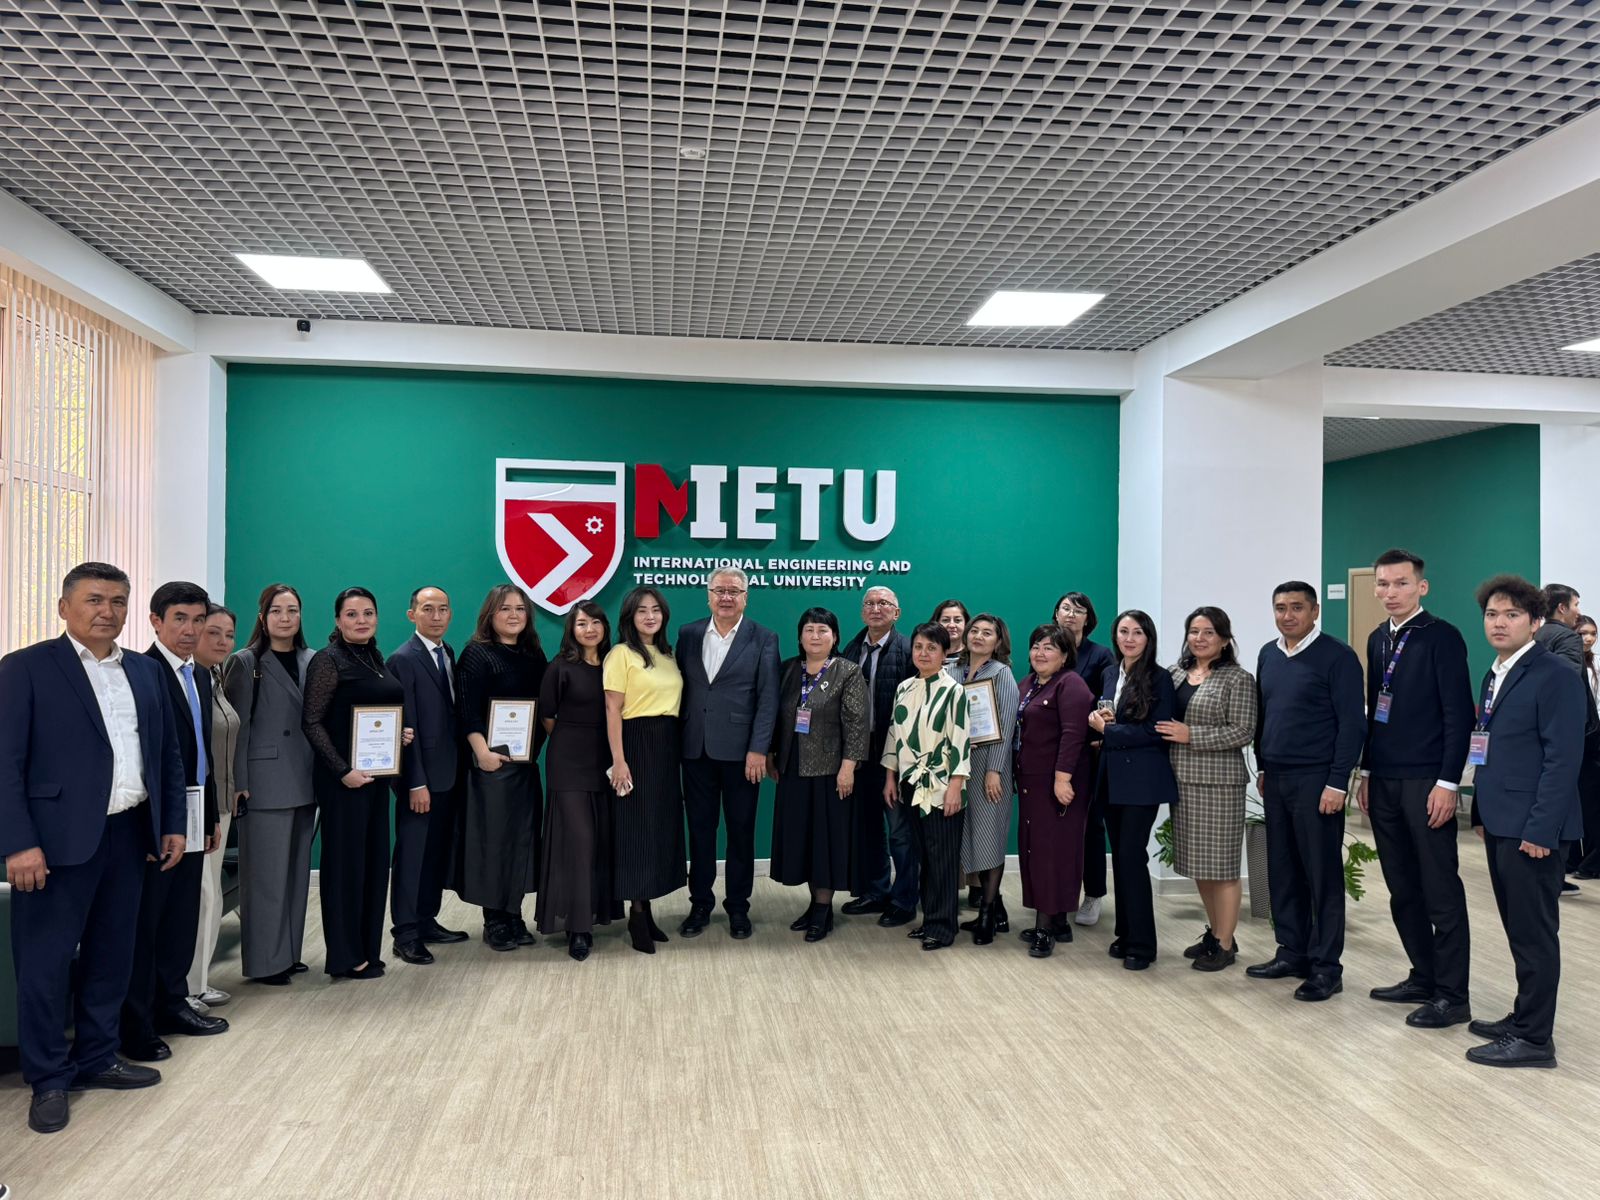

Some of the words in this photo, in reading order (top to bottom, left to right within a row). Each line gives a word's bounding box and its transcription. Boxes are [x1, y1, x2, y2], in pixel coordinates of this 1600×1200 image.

[634, 463, 897, 542] MIETU
[633, 556, 763, 570] INTERNATIONAL
[768, 558, 874, 571] ENGINEERING
[878, 560, 911, 572] AND
[633, 573, 769, 586] TECHNOLAL
[773, 575, 867, 588] UNIVERSITY
